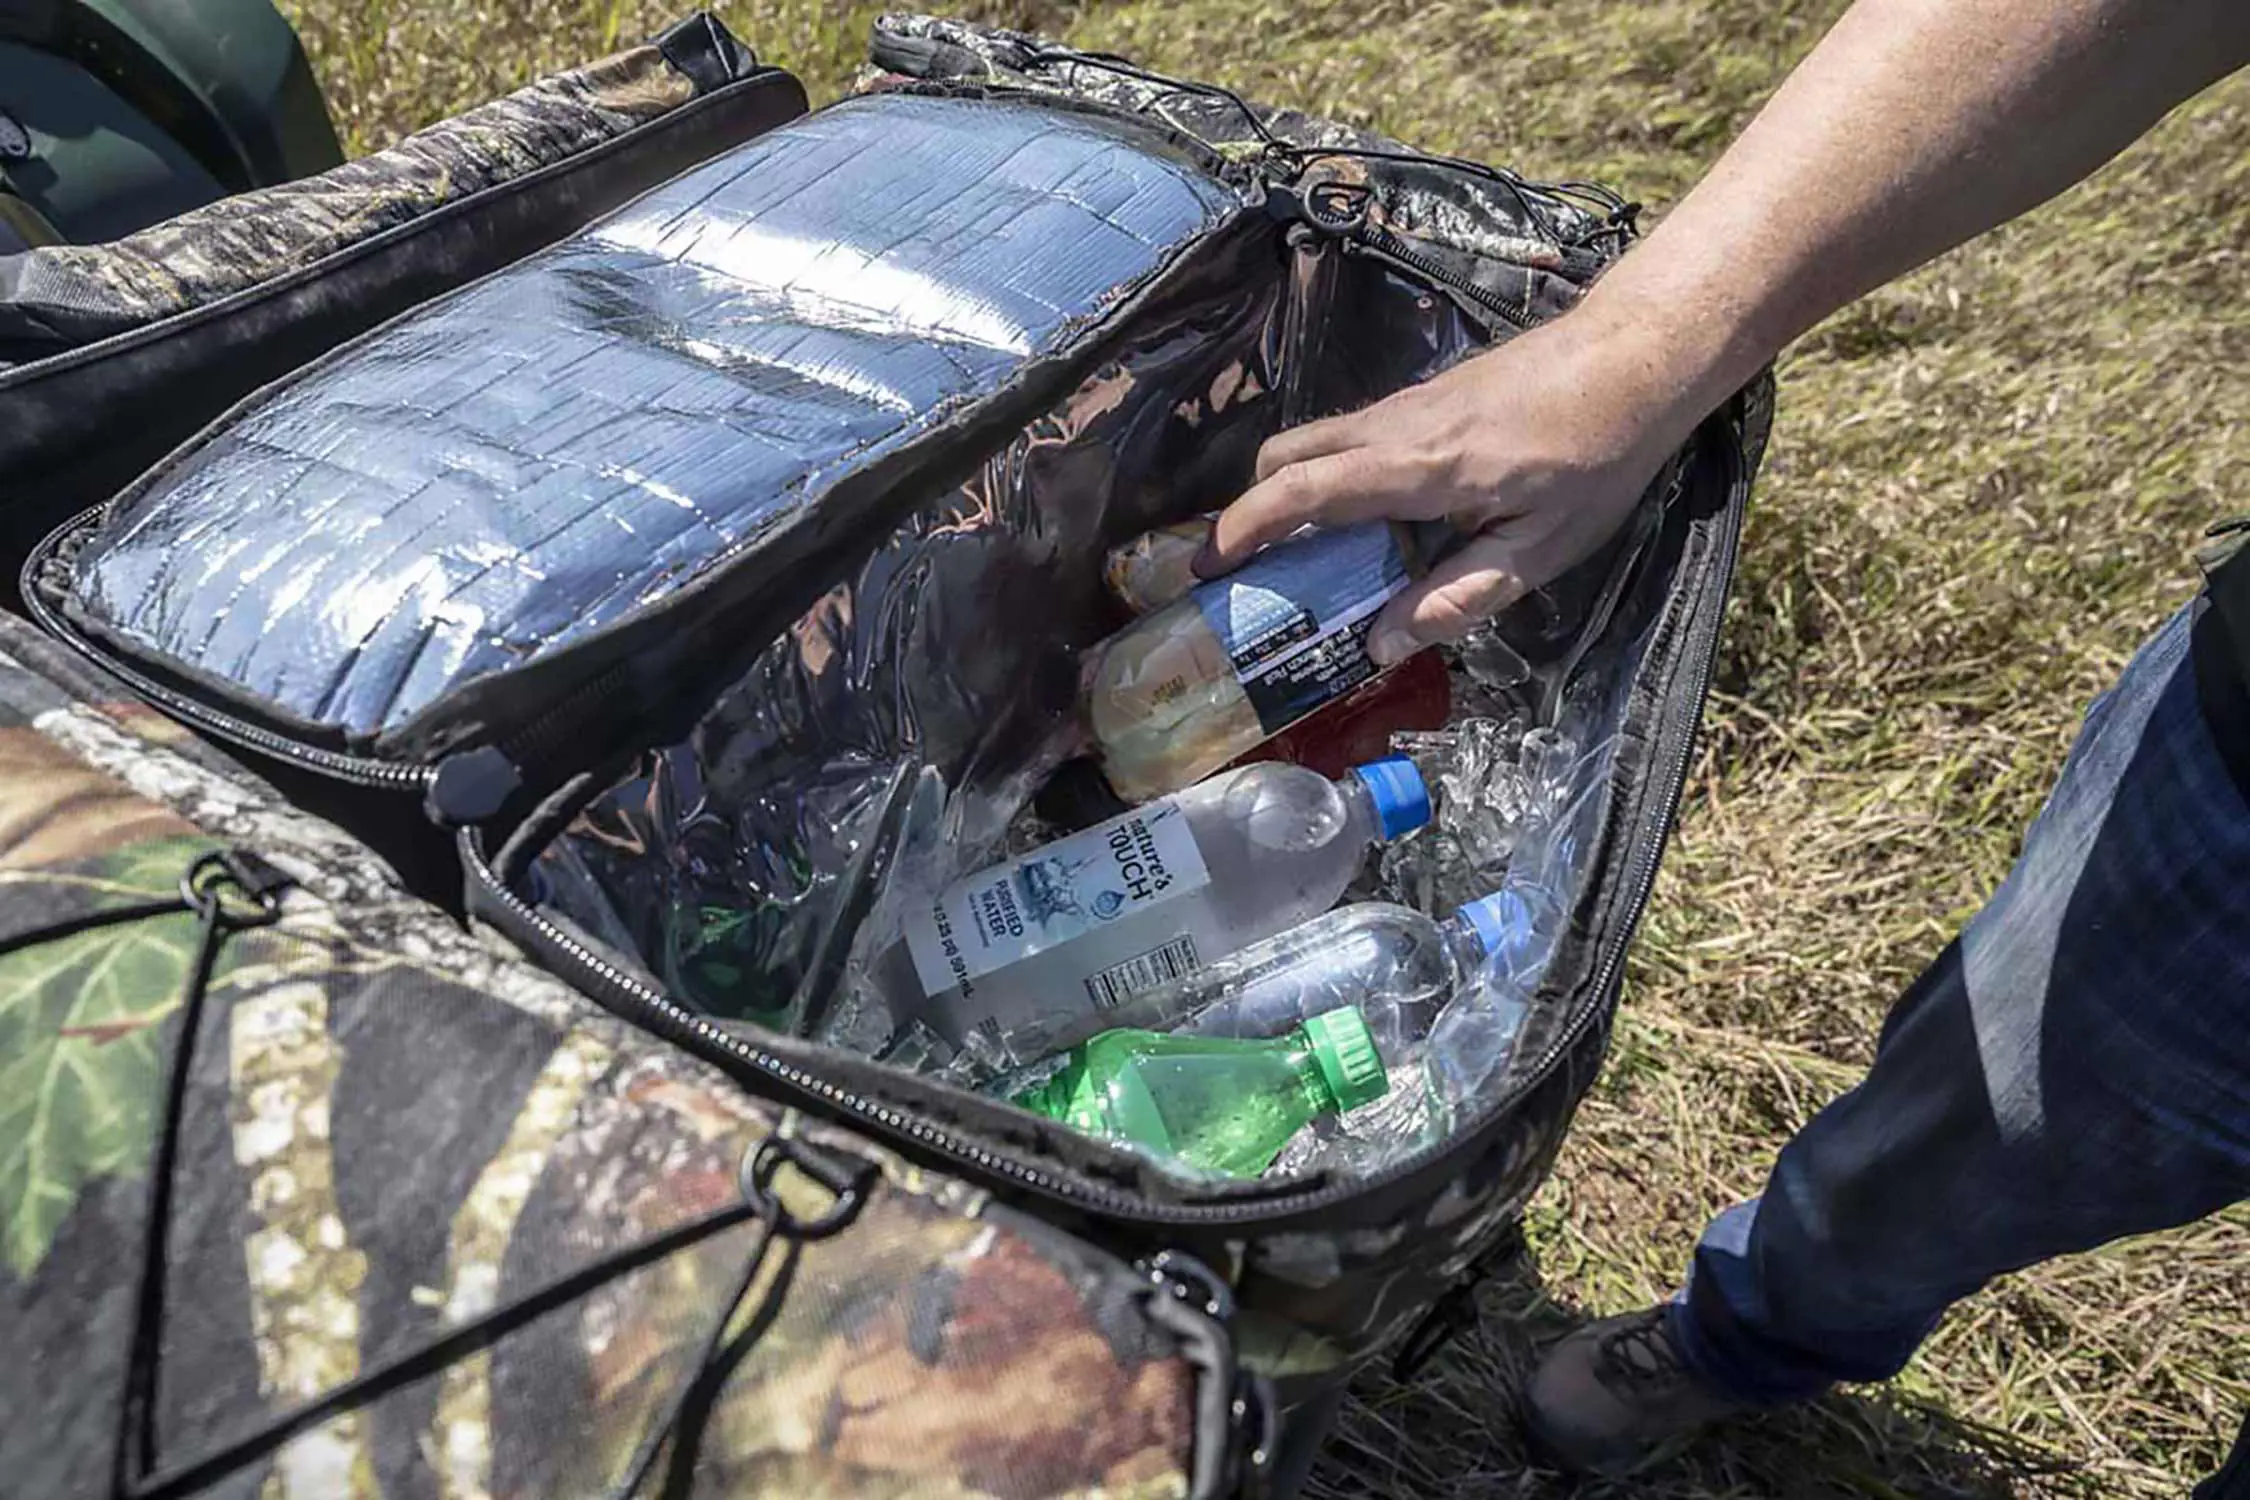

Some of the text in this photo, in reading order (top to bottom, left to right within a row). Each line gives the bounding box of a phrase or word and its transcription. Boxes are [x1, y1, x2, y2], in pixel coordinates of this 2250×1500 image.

[1262, 665, 1287, 686] Roll
[1289, 653, 1333, 684] Cheese
[1107, 825, 1153, 901] TOUCH
[1126, 818, 1172, 891] nature's
[979, 889, 1004, 937] WATER
[995, 879, 1024, 936] PURIFIED
